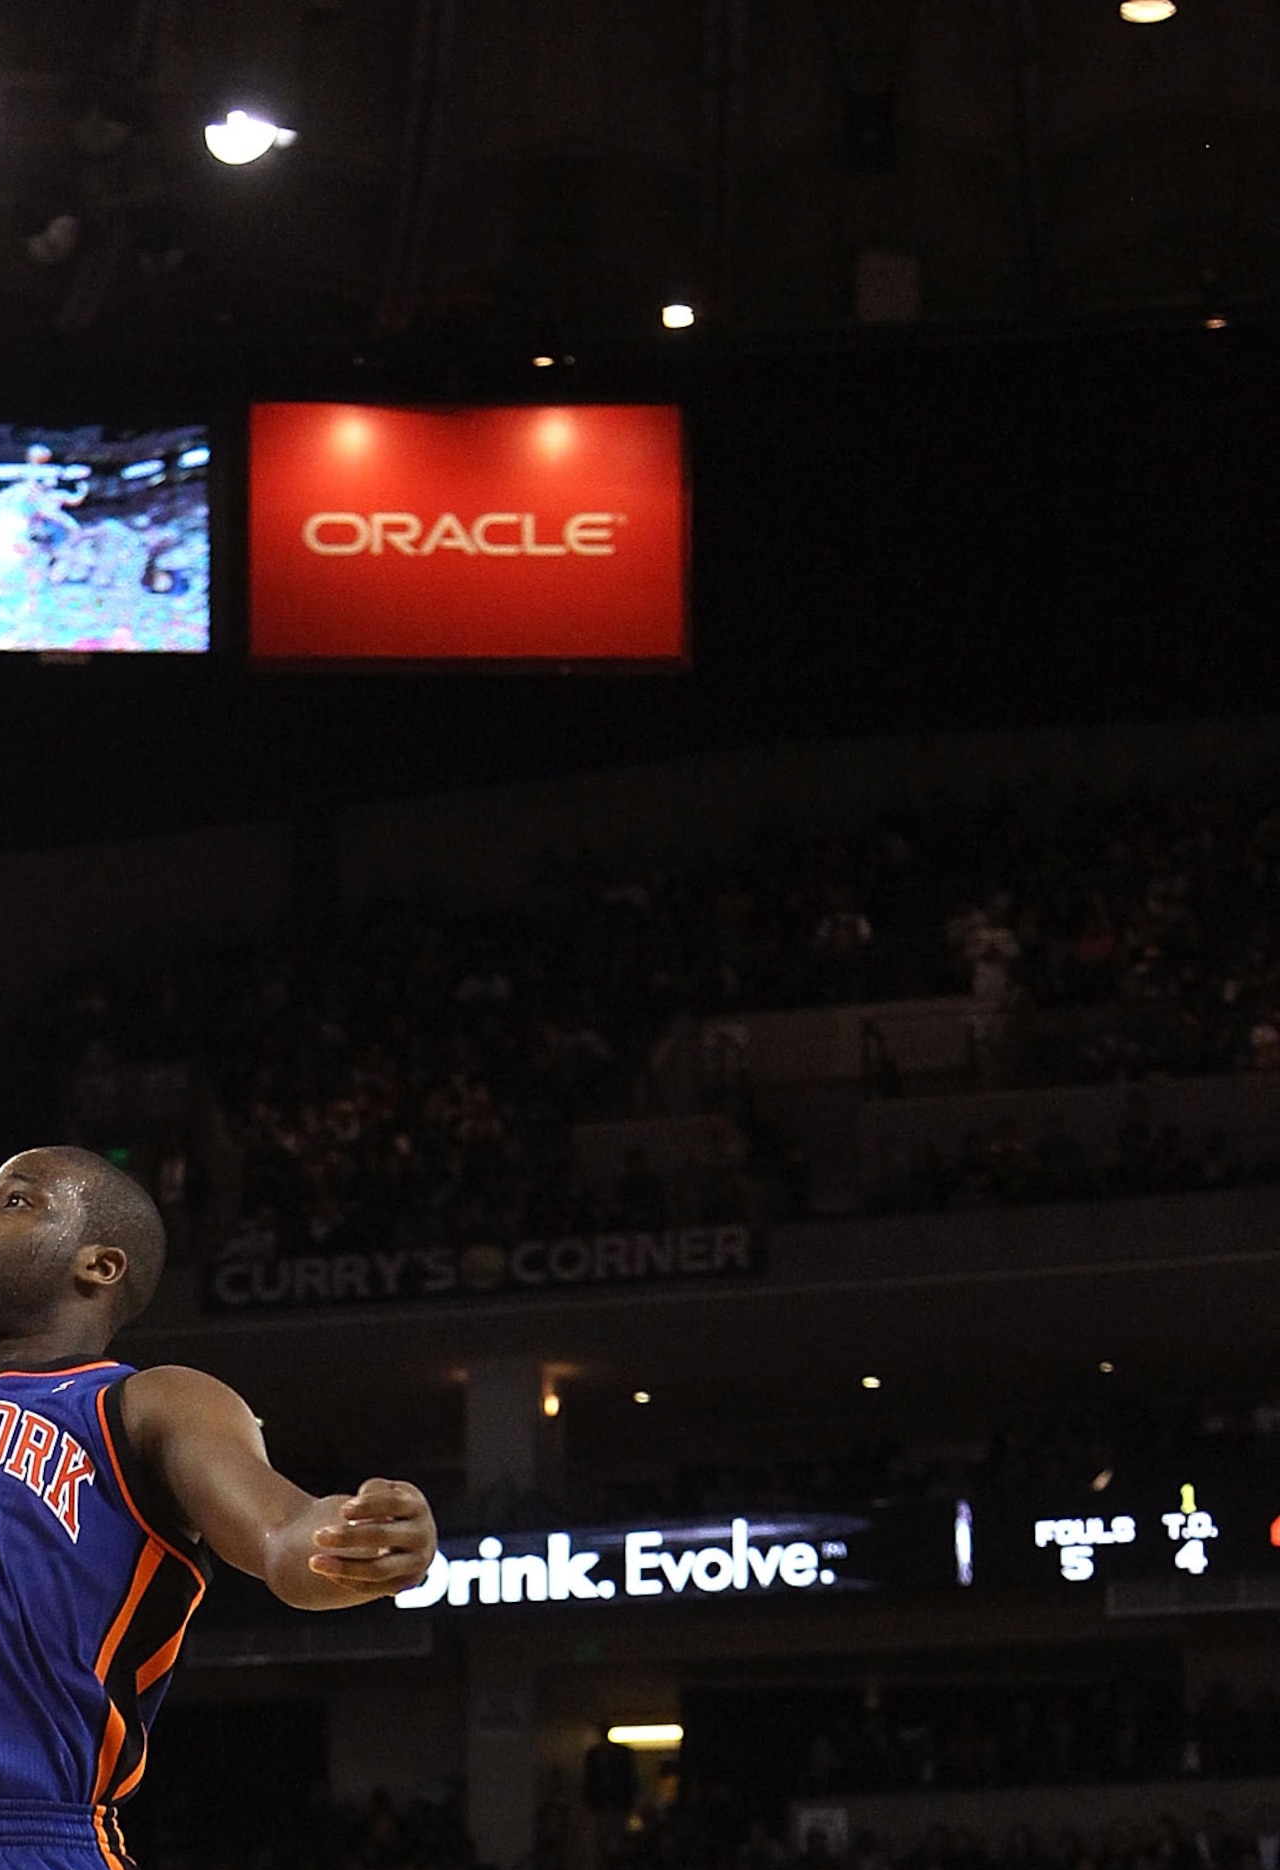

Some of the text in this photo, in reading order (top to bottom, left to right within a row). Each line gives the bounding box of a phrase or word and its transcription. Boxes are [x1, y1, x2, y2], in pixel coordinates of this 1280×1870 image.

[302, 512, 618, 557] ORACLE
[512, 1225, 751, 1283] CORNER
[1035, 1515, 1136, 1547] FOULS
[624, 1517, 837, 1596] Evolve.
[1060, 1539, 1208, 1581] 5 4
